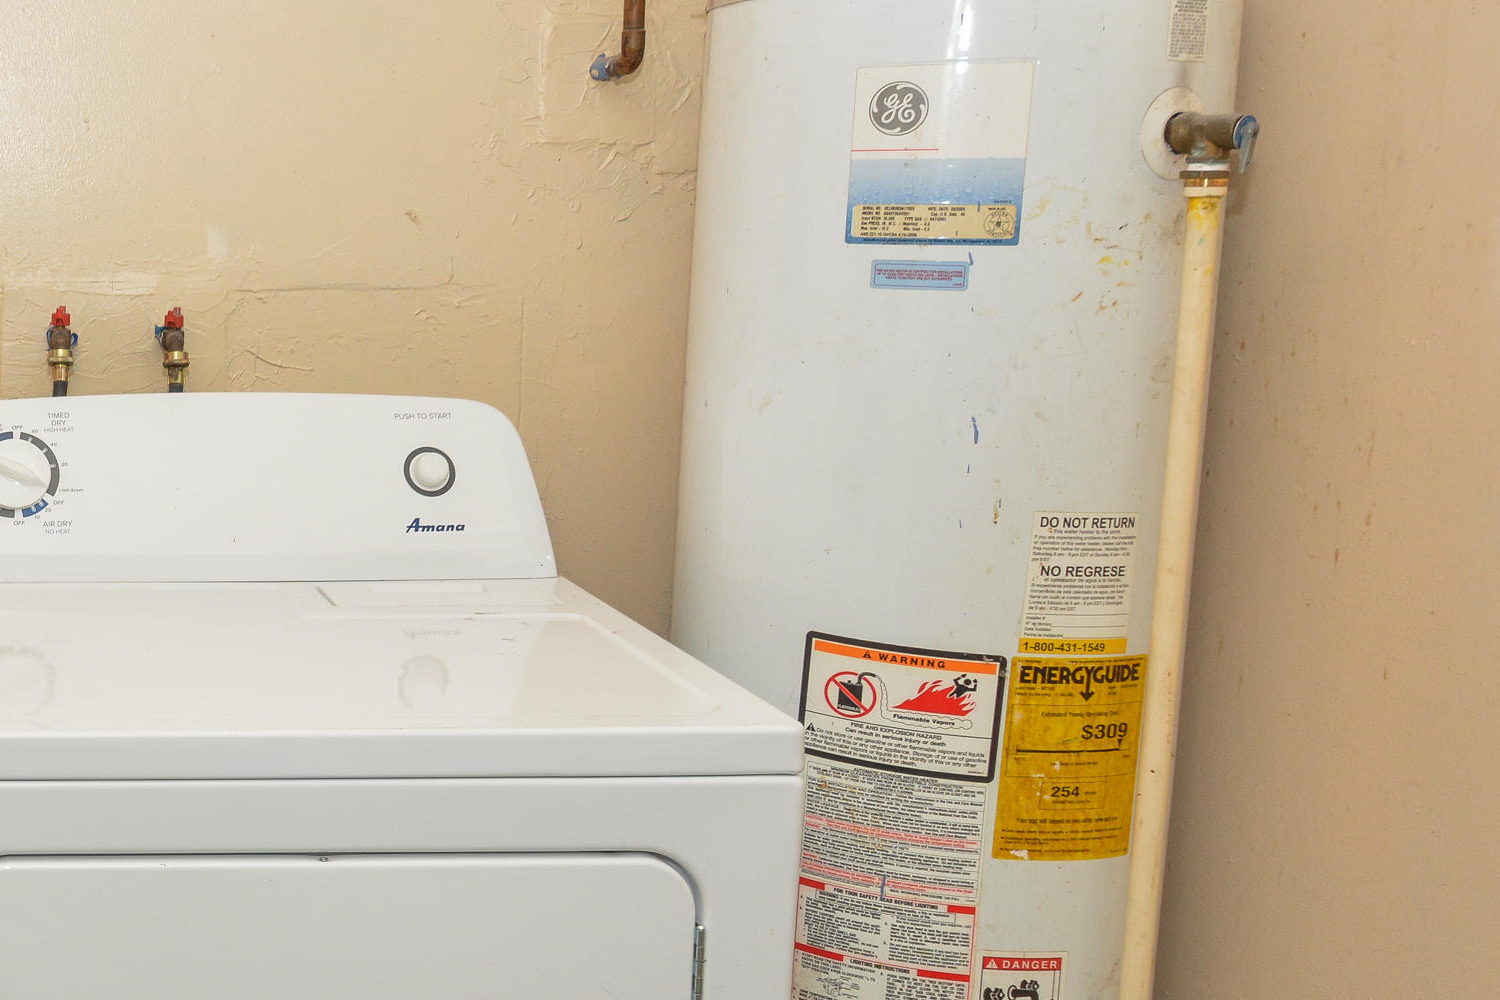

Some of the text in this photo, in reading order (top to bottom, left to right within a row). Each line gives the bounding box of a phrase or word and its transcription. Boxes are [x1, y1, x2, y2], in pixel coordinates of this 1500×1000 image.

[406, 518, 465, 533] Amana
[1040, 516, 1135, 528] DO NOT RETURN
[1040, 566, 1126, 577] NO REGRESE
[1023, 641, 1105, 652] 1-800-431-1549
[879, 653, 946, 669] WARNING
[1020, 663, 1140, 684] ENERGYGUIDE
[893, 714, 930, 723] Flammable
[880, 728, 915, 737] EXPLOSION
[1081, 723, 1128, 740] $309
[1051, 786, 1080, 797] 254
[1002, 960, 1058, 970] DANGER
